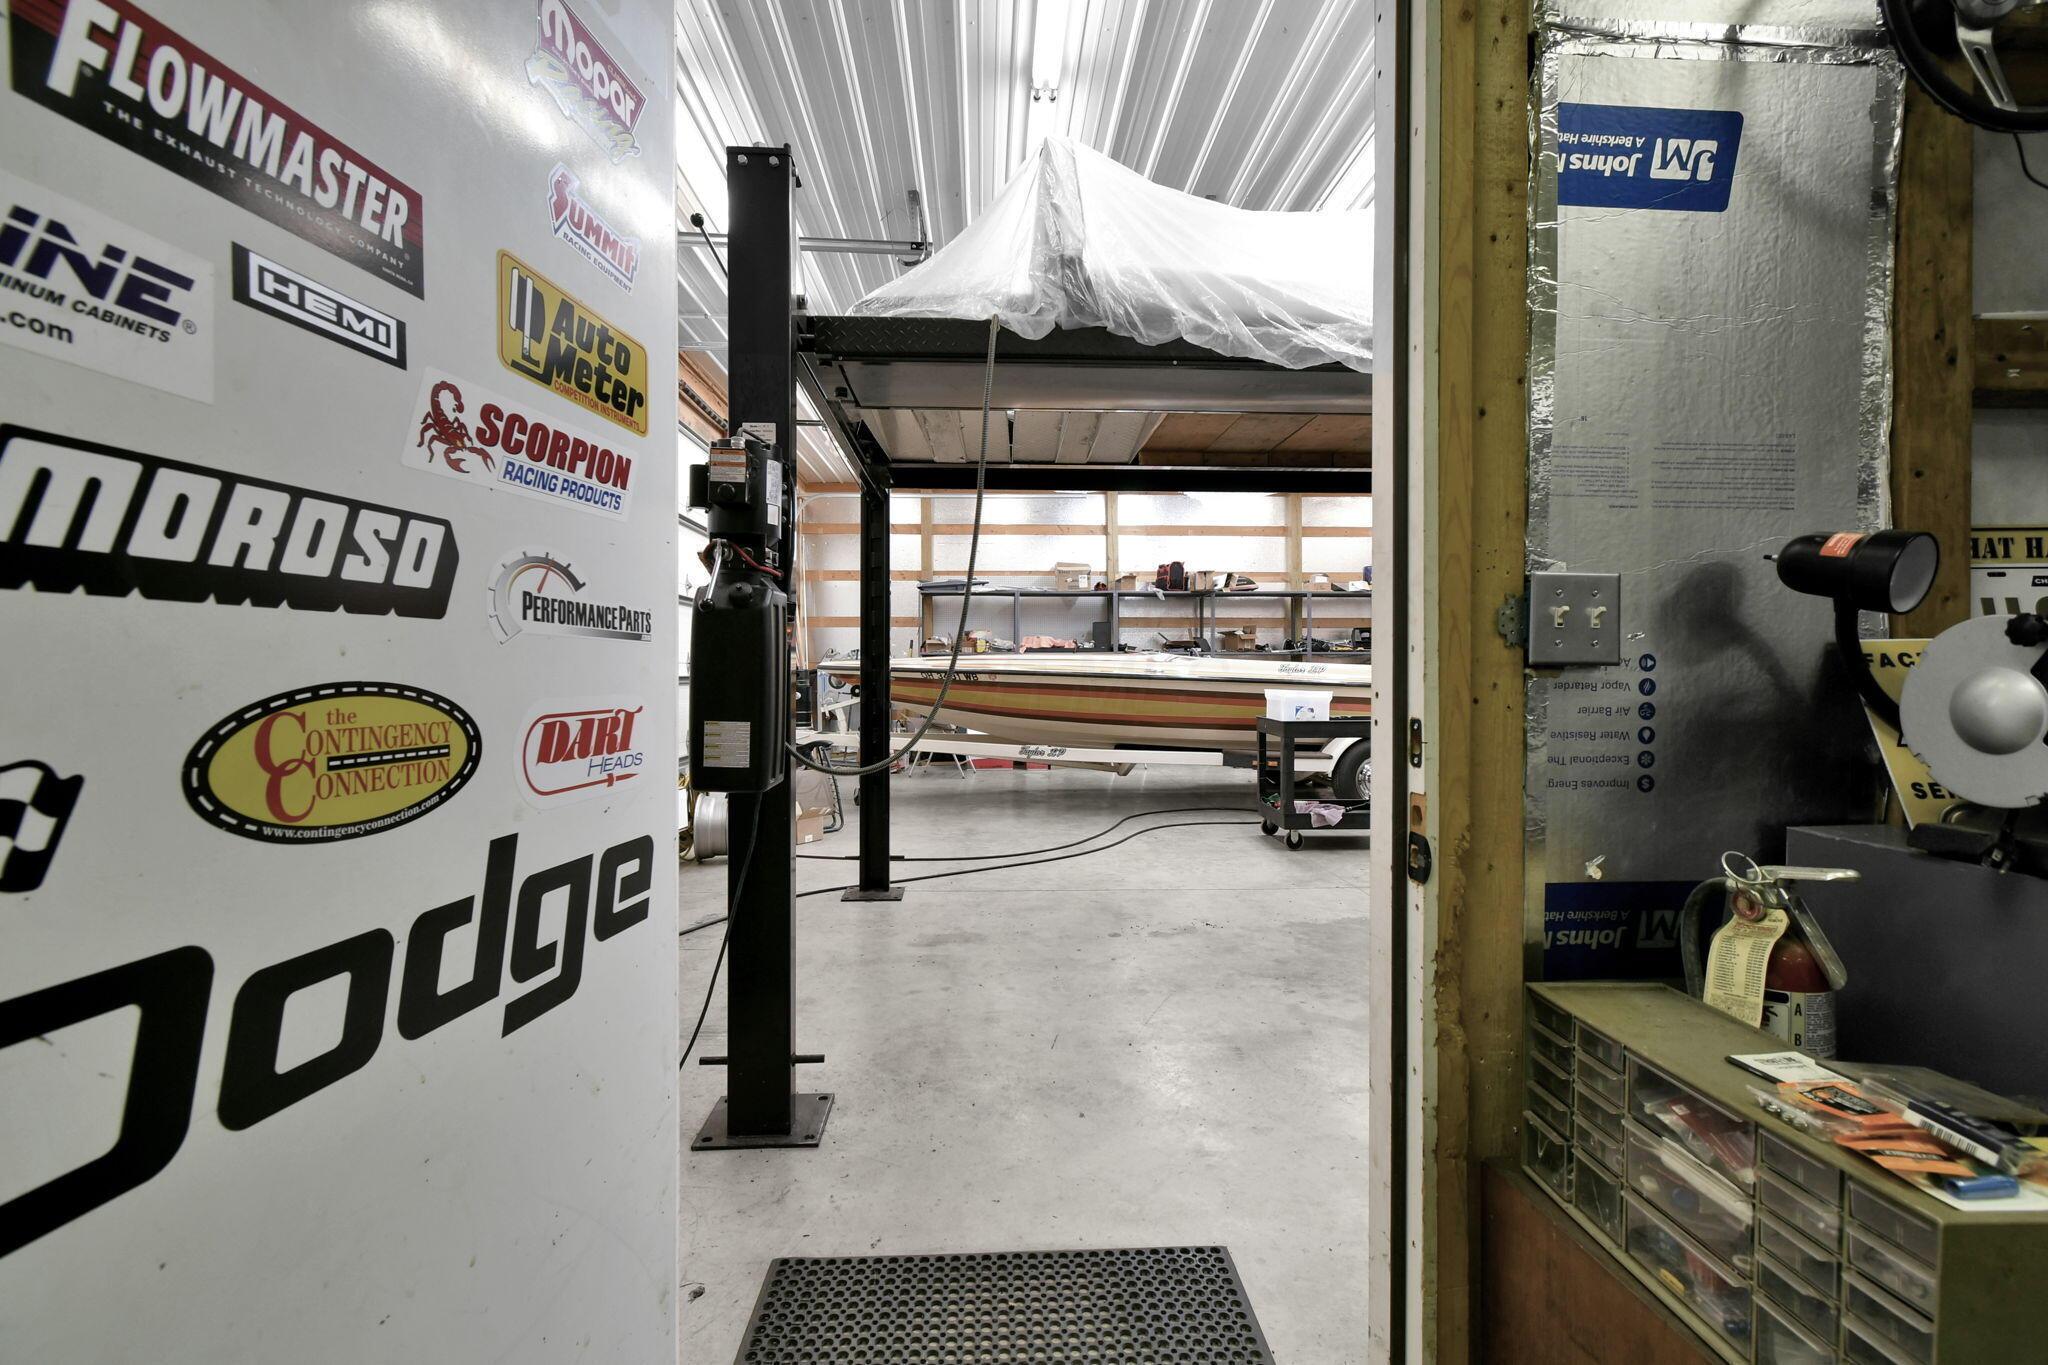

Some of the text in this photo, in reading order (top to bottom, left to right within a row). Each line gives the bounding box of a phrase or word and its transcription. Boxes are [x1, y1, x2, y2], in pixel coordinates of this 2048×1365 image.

[46, 0, 409, 249] FLOWMASTER
[1581, 134, 1633, 148] Berkshire
[1636, 137, 1645, 148] A
[1569, 153, 1643, 177] Johns
[1650, 137, 1718, 181] JM
[103, 101, 405, 269] THE EXHAUST TECHNOLOGY COMPANY
[563, 232, 632, 294] RACING EQUIPMENT
[0, 271, 171, 343] INUM CABINETS
[262, 271, 388, 345] HEMI
[551, 298, 631, 376] Auto
[544, 333, 645, 418] Meter
[553, 379, 640, 430] COMPETITION INSTRUMENTS
[475, 403, 632, 491] SCORPION
[503, 460, 622, 511] RACING PRODUCTS
[0, 437, 446, 589] MOROSO
[1554, 682, 1631, 692] Vapor Retarder
[326, 708, 357, 725] the
[1577, 707, 1631, 717] Air Barrier
[254, 711, 452, 777] CONTINGENCY
[536, 705, 643, 766] DART
[1550, 731, 1631, 741] Water Resistive
[587, 752, 643, 777] HEADS
[1569, 755, 1630, 765] Exceptional
[265, 758, 451, 824] CONNECTION
[1546, 778, 1630, 789] Improves Energ
[262, 795, 440, 839] www.contingencyconnection.com
[1567, 910, 1618, 922] Berkshire
[1556, 928, 1628, 949] Johns
[1794, 1003, 1802, 1017] A
[1794, 1033, 1802, 1046] B
